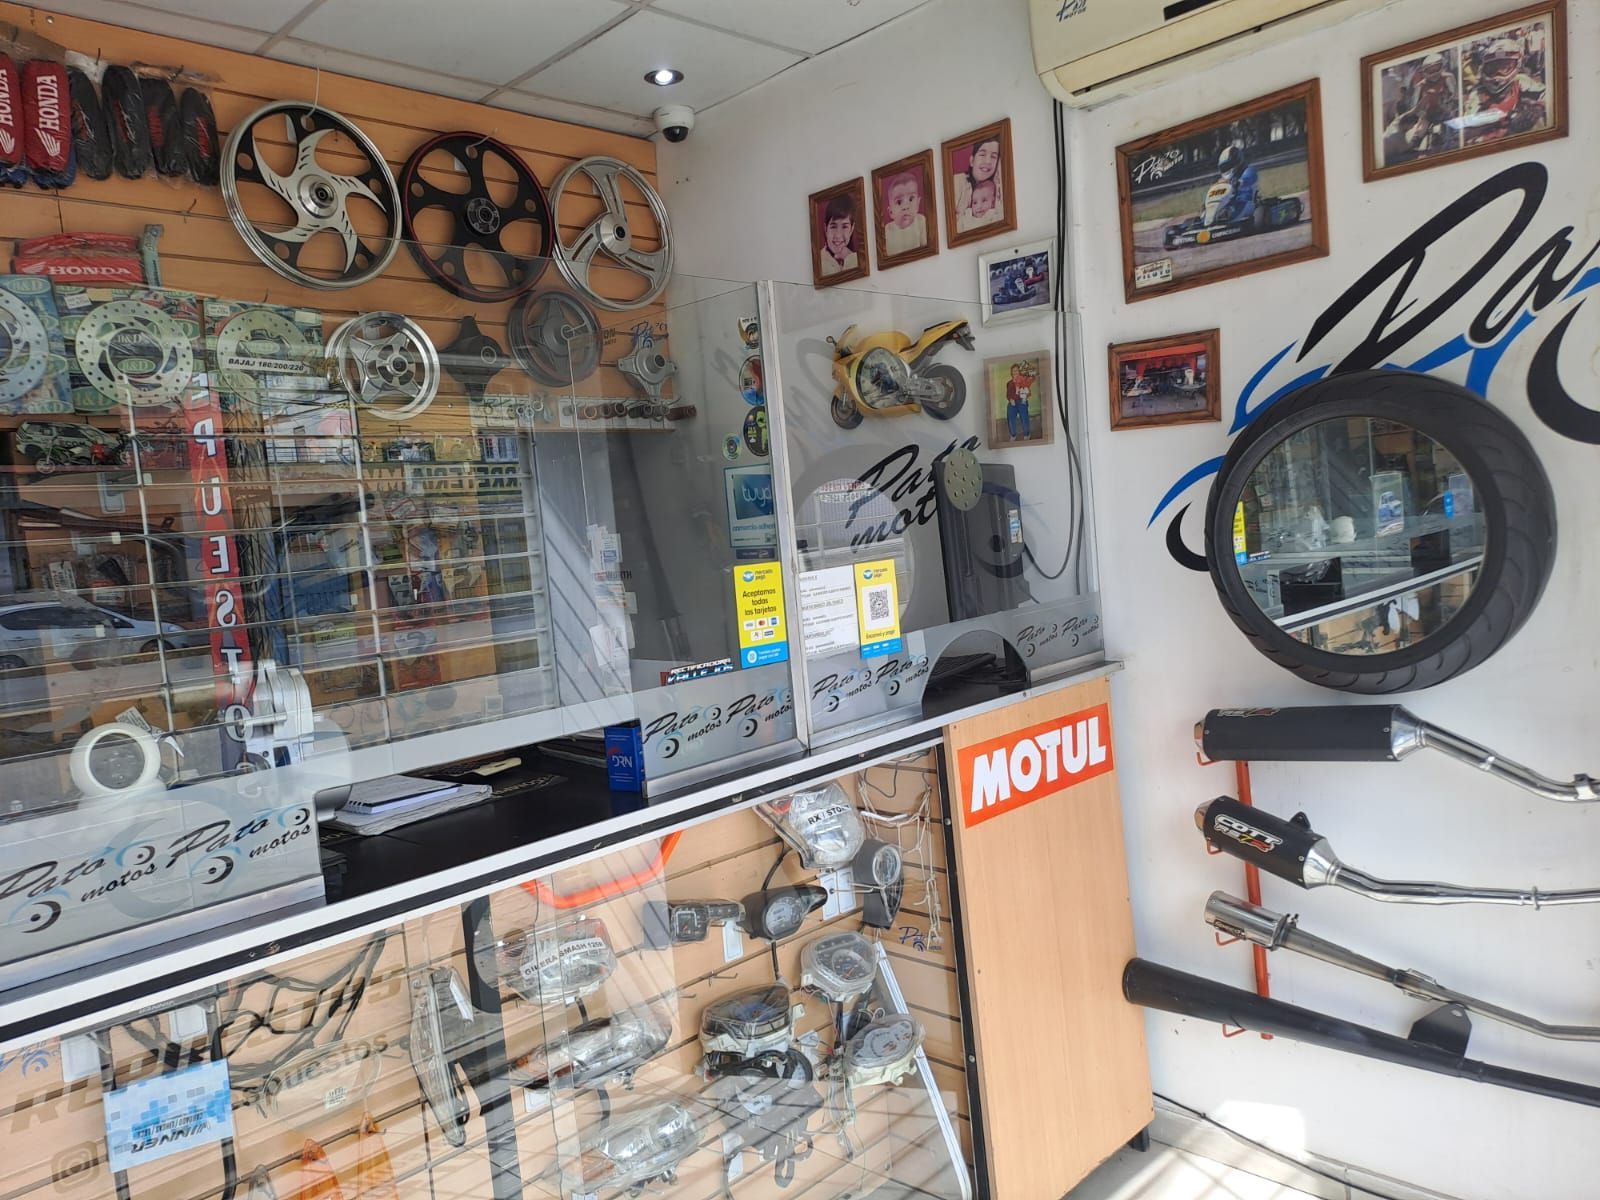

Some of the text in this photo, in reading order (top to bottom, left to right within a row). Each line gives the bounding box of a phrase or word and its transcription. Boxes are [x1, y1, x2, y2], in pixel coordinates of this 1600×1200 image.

[37, 74, 60, 131] HONDA
[48, 266, 131, 275] HONDA
[228, 357, 255, 367] BAJAJ
[742, 587, 776, 598] Aceptamos
[751, 597, 769, 606] todas
[744, 604, 777, 616] las tarjetas
[875, 659, 913, 685] Pato
[905, 666, 928, 683] motos
[812, 673, 854, 700] Pato
[846, 680, 873, 697] motos
[726, 694, 774, 724] Pato
[643, 711, 699, 744] Pato
[687, 719, 722, 741] motos
[971, 716, 1106, 812] MOTUL
[808, 813, 821, 825] RX
[1215, 814, 1282, 845] COTT
[166, 817, 269, 868] Pato
[249, 824, 312, 858] motos
[0, 857, 105, 899] Pato
[81, 862, 157, 902] motos
[524, 954, 558, 976] GILERA
[559, 942, 587, 957] SMASH
